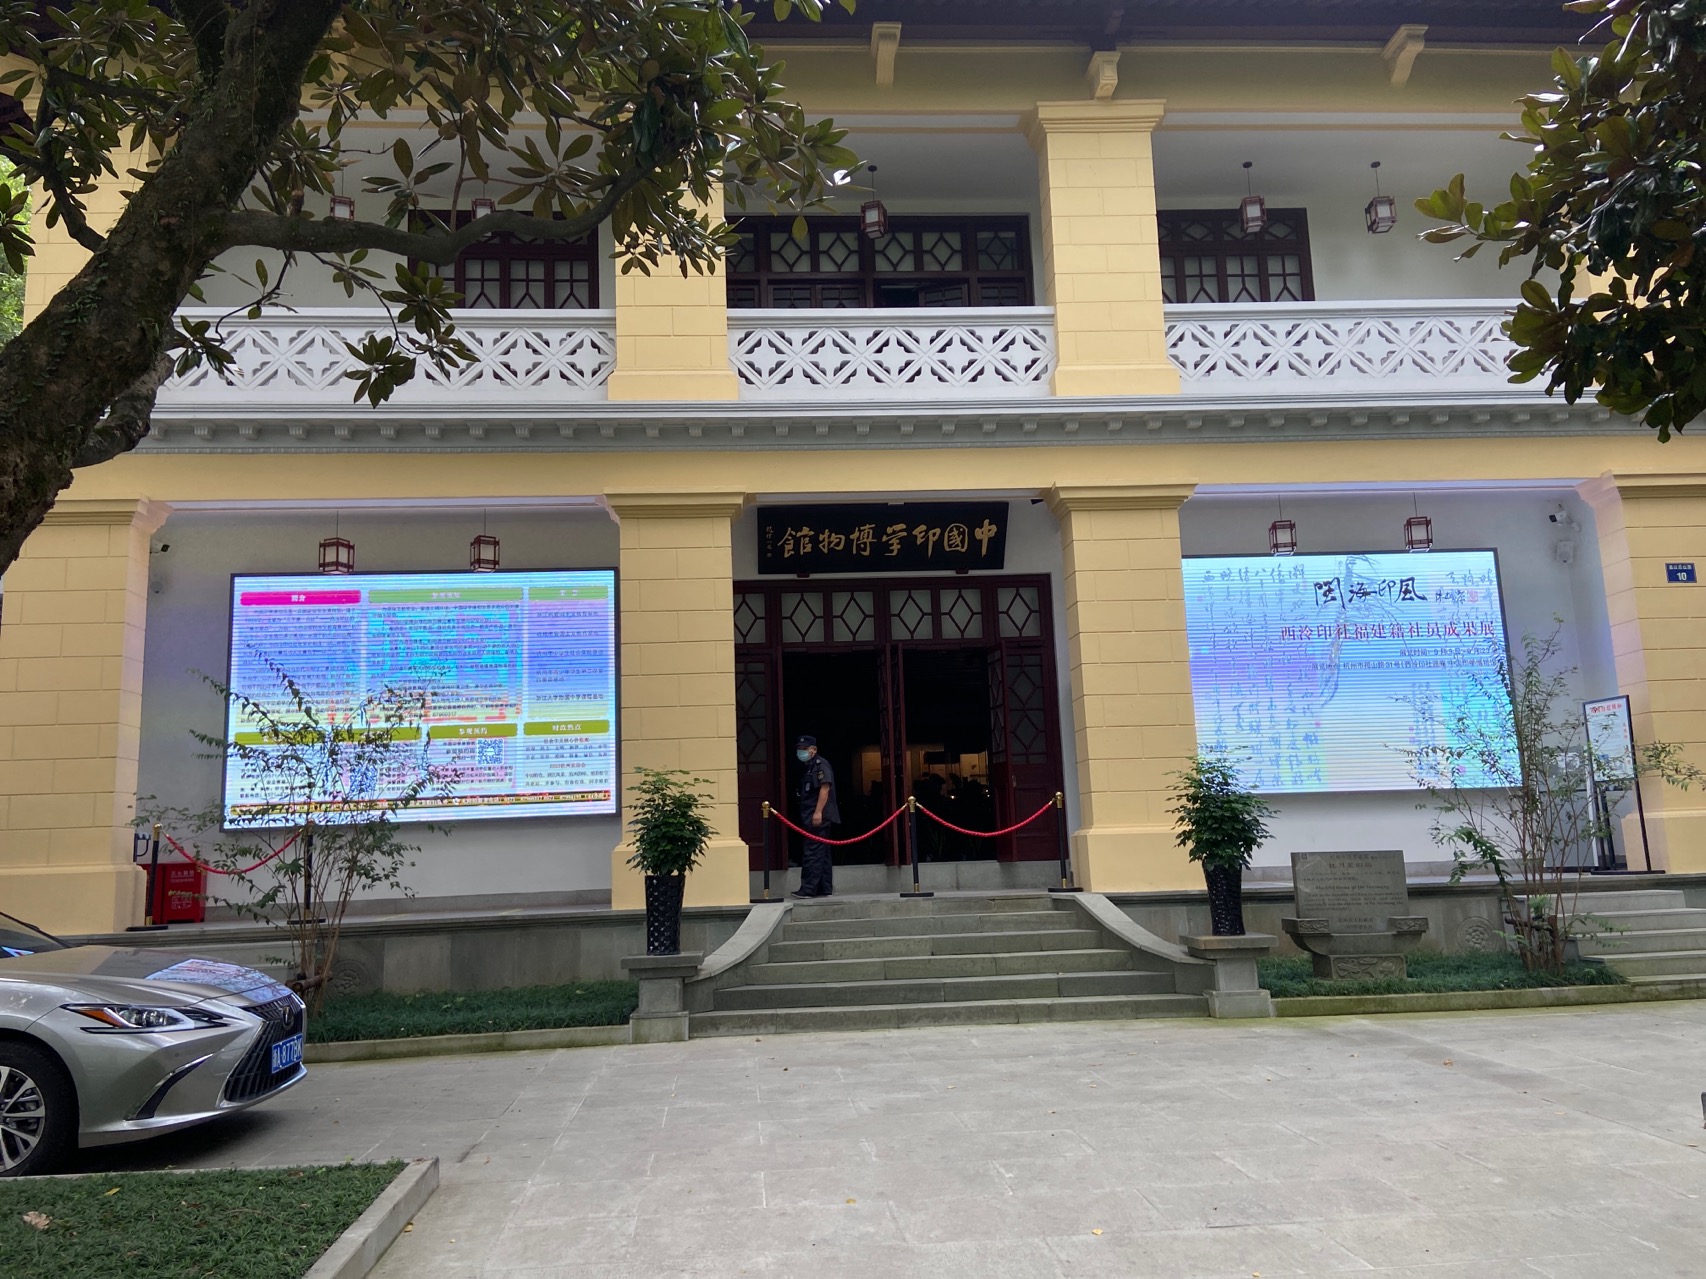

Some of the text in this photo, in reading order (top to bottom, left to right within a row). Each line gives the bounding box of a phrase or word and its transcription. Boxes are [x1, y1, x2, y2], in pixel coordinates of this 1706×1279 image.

[1676, 572, 1687, 581] 10
[1281, 620, 1495, 641] 西泠印社福建籍社员成果展
